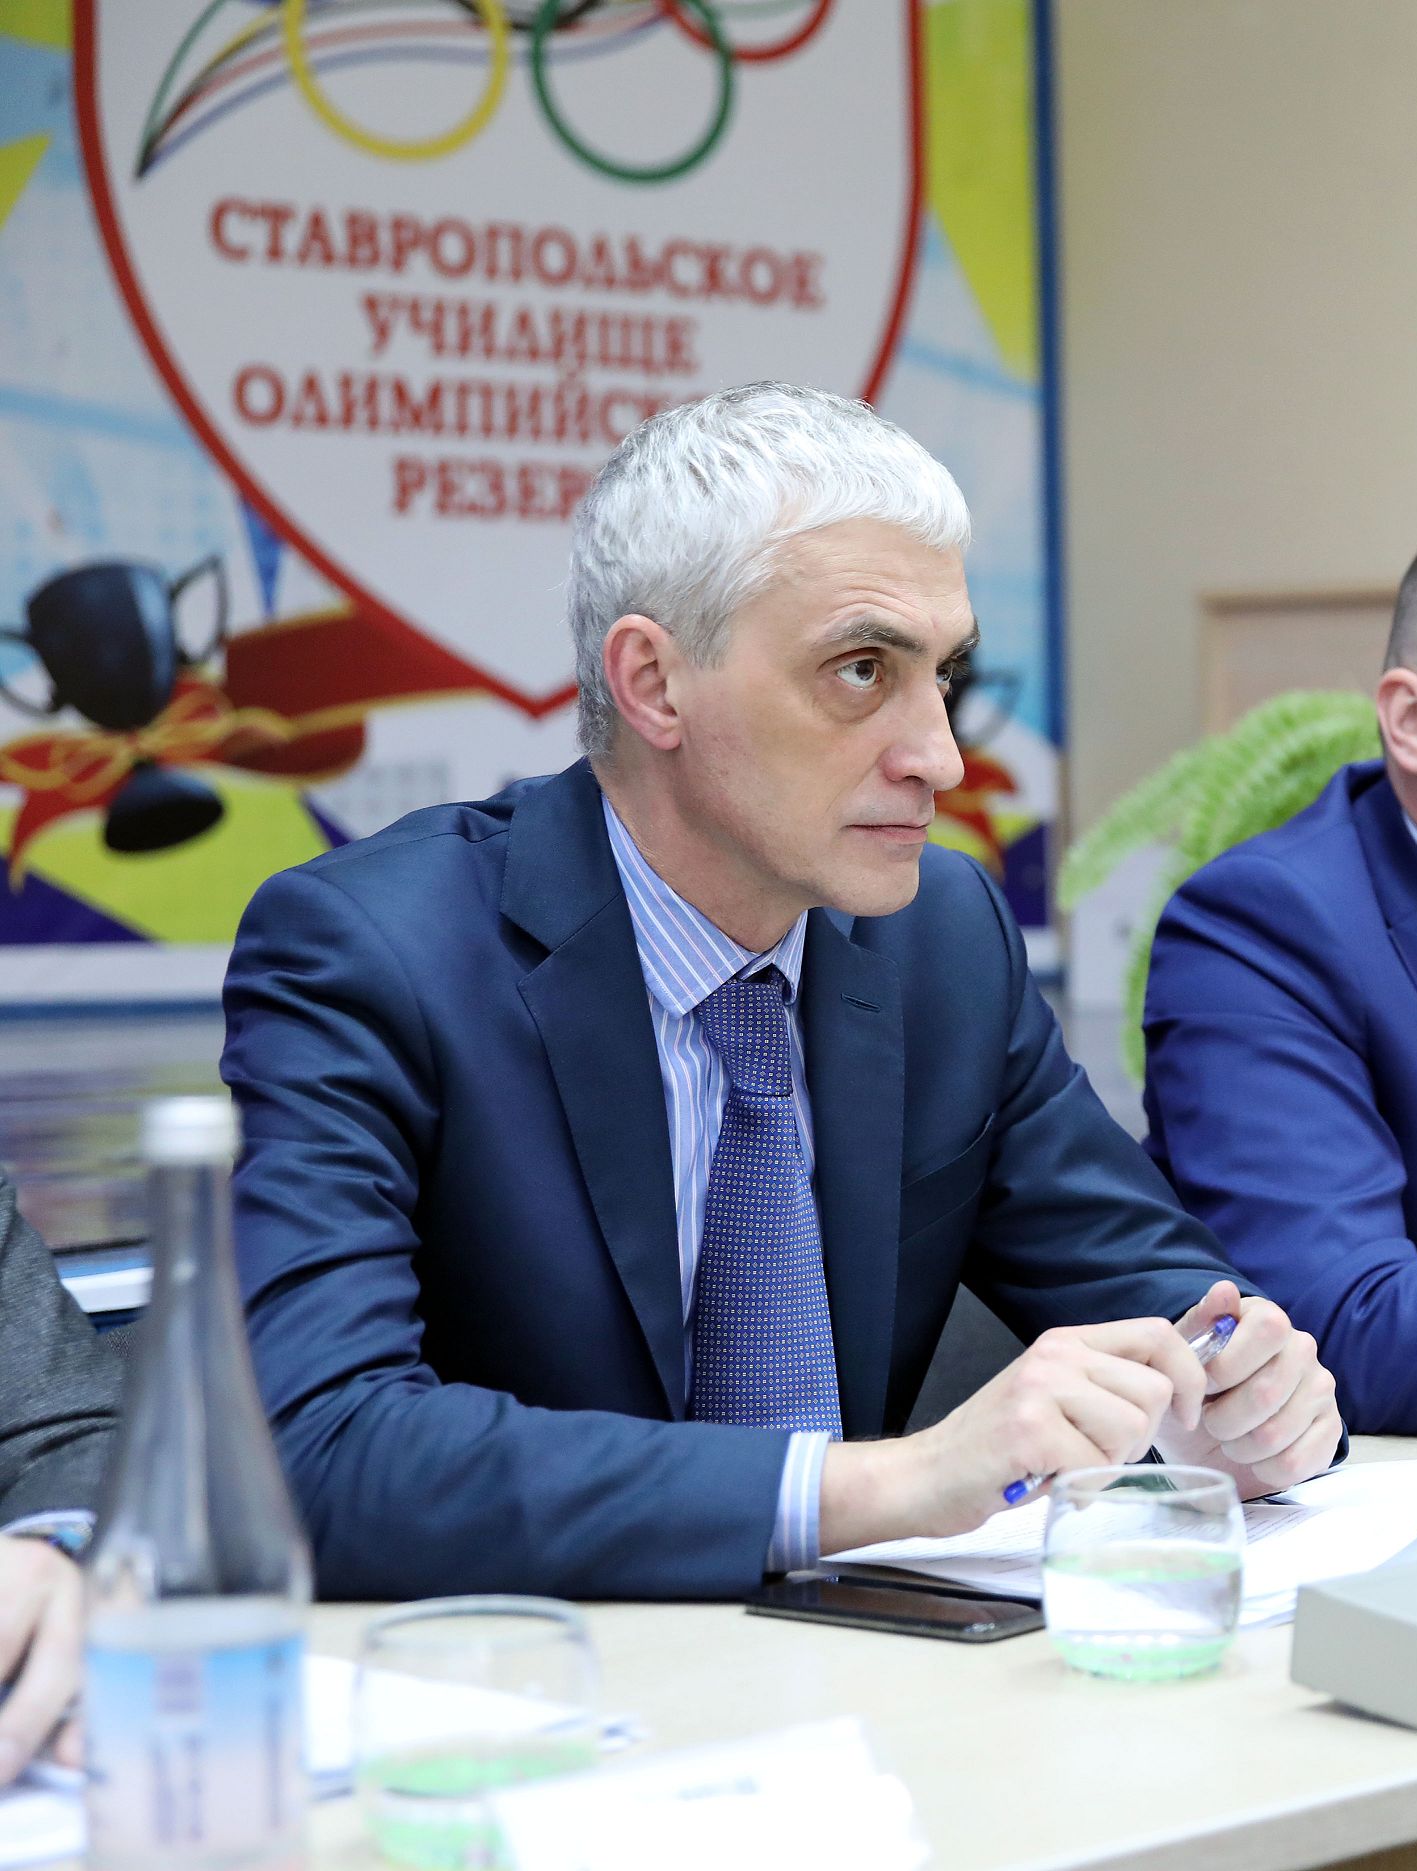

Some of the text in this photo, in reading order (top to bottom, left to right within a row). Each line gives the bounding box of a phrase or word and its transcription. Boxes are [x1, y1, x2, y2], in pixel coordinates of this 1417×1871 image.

[210, 199, 828, 310] СТАВРОПОЛЬСКОЕ
[361, 292, 699, 377] УЧИЛИЩЕ
[232, 363, 706, 446] ОЛИМПИЙС
[393, 455, 599, 520] РЕЗЕР
